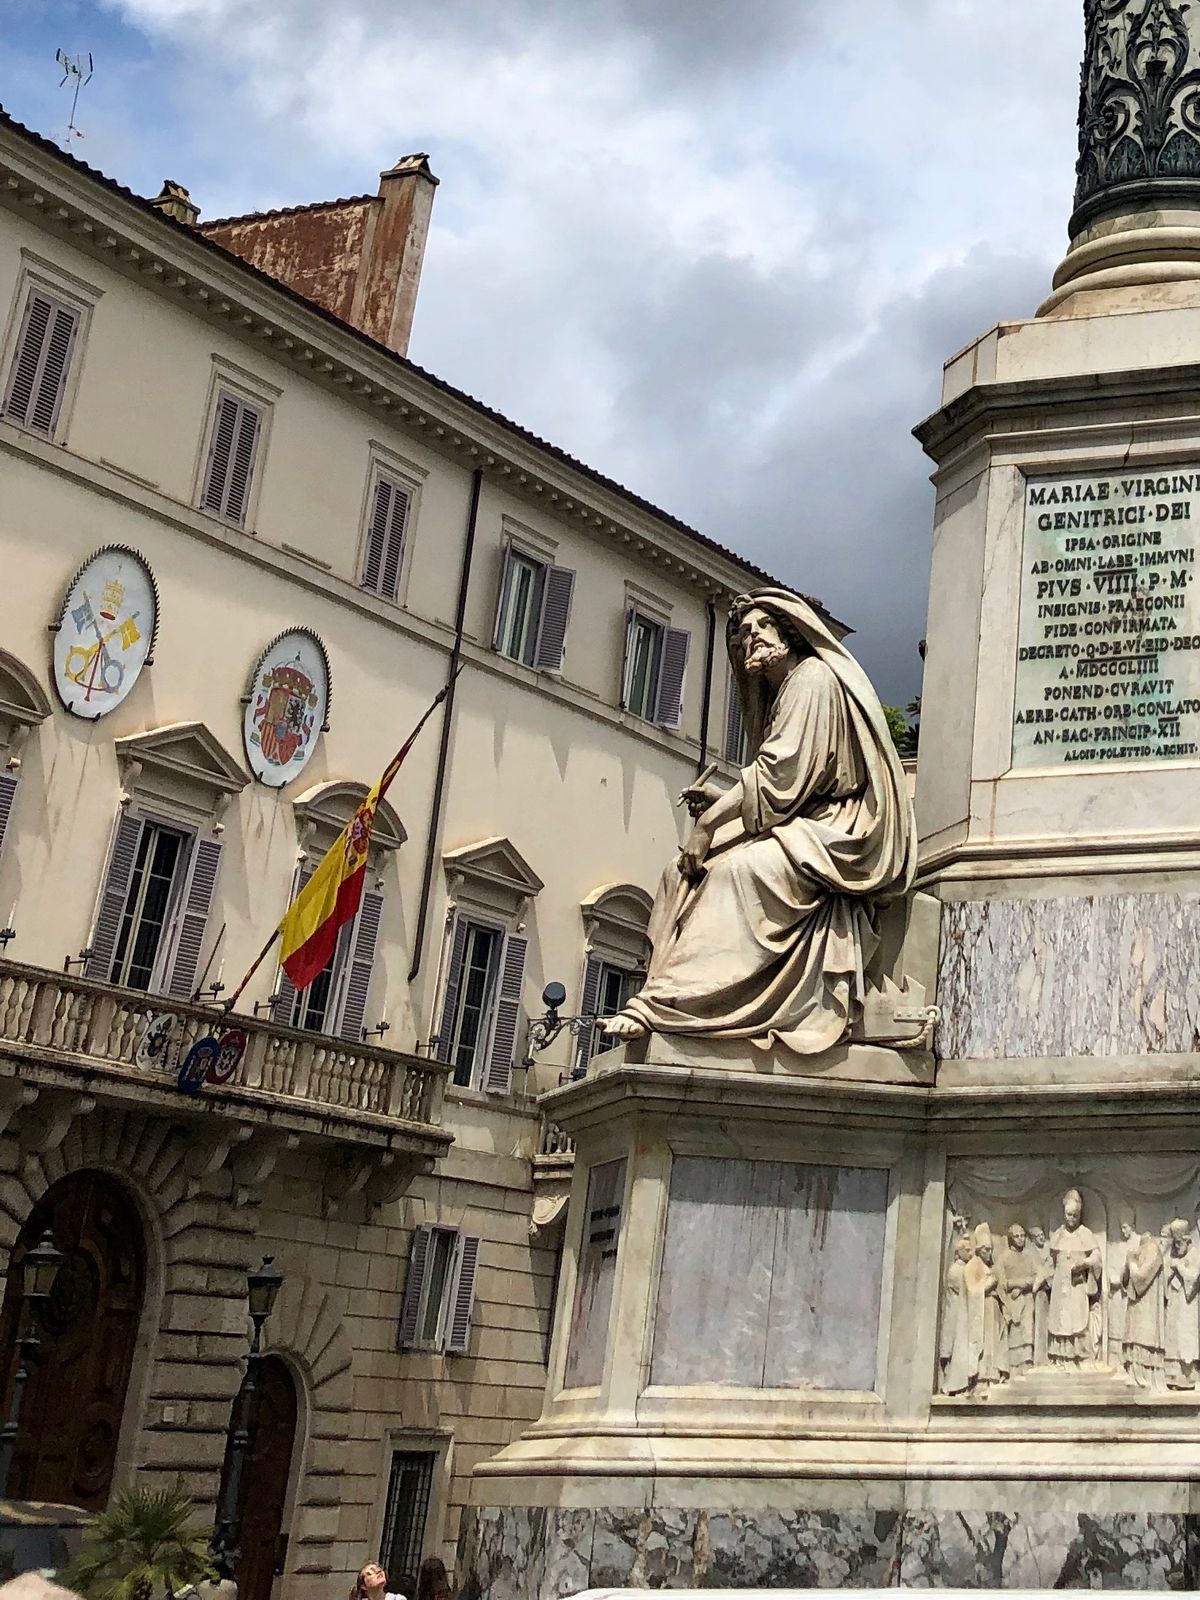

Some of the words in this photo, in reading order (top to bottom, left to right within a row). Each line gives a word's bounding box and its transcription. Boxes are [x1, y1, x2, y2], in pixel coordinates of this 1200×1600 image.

[1029, 482, 1109, 506] MARIAE
[1038, 506, 1145, 531] GENITRICI
[1155, 502, 1191, 522] DEI
[1065, 537, 1096, 552] IPSA
[1098, 554, 1132, 569] LABE
[1037, 578, 1081, 599] PIVS
[1149, 572, 1159, 591] P
[1170, 570, 1187, 588] M
[1084, 617, 1177, 635] CONFIRMATA
[1033, 731, 1054, 744] AN
